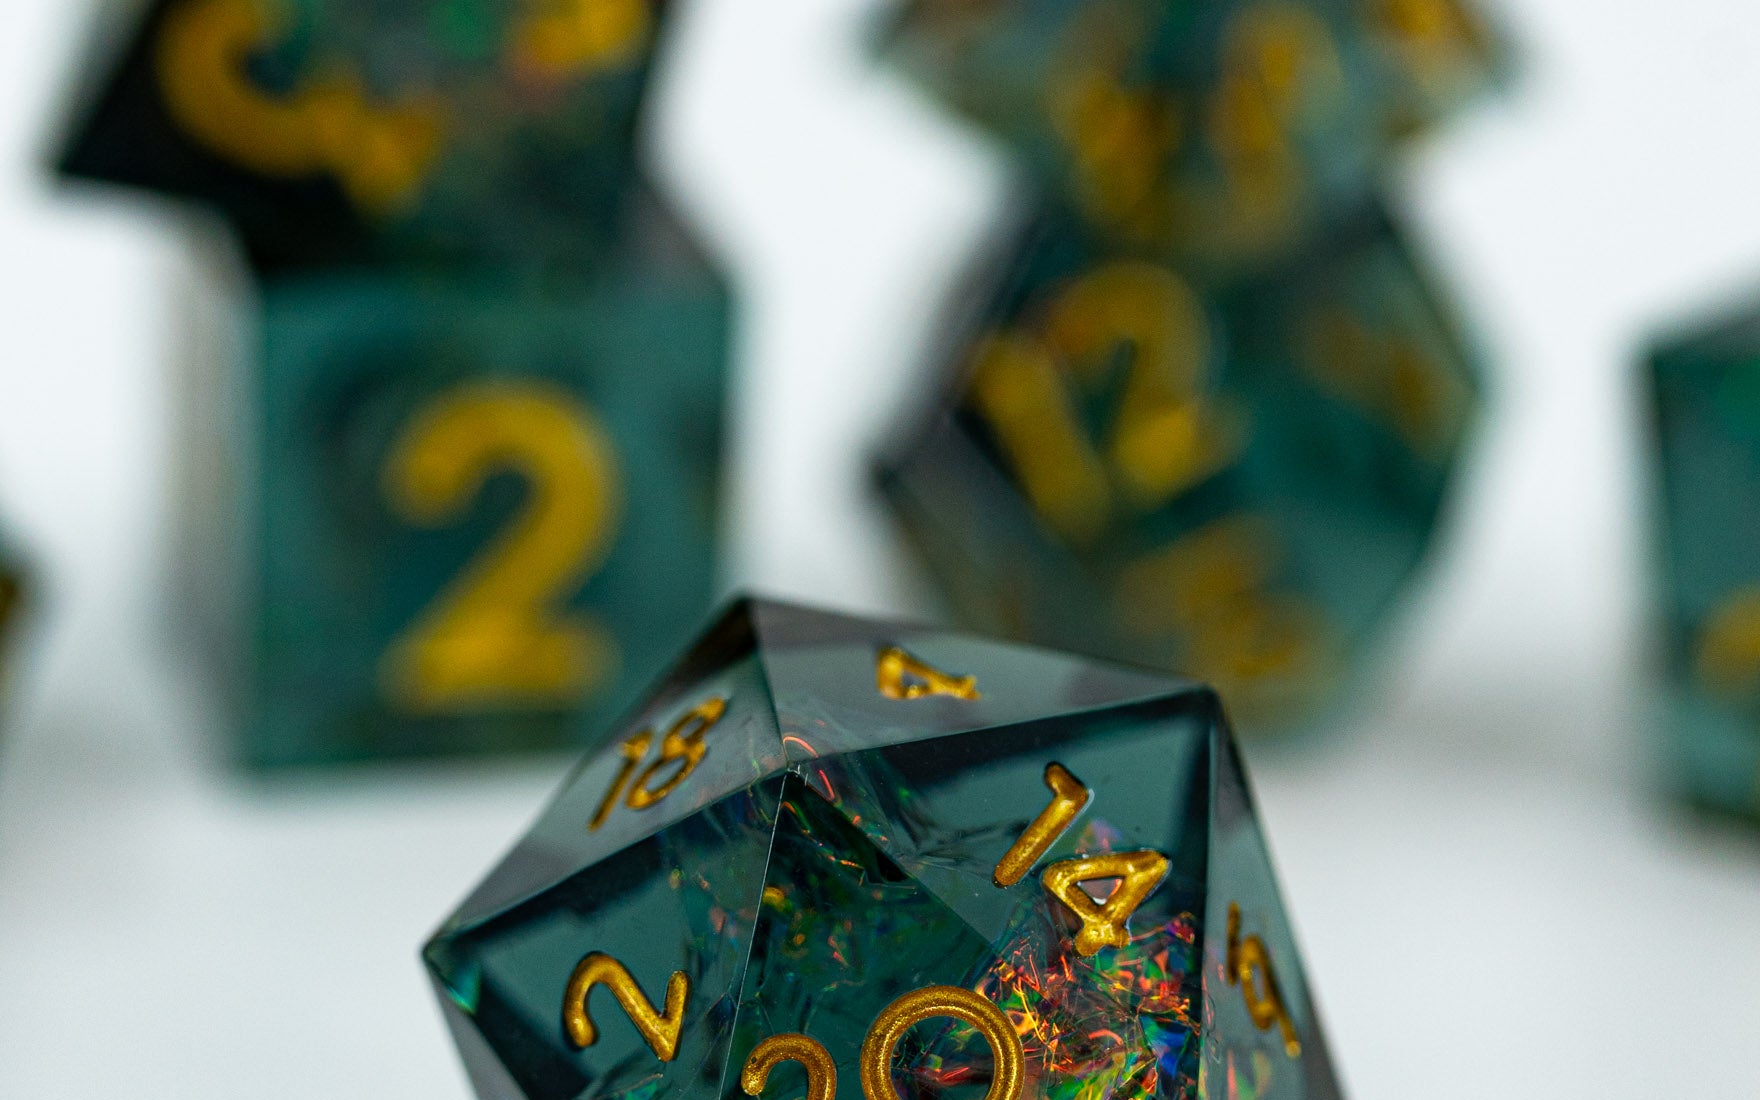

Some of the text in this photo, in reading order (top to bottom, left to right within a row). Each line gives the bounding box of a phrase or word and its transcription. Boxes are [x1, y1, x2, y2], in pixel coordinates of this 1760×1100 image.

[388, 382, 620, 706] 2
[587, 697, 726, 831] 18
[993, 761, 1171, 957] 14
[563, 950, 691, 1062] 2
